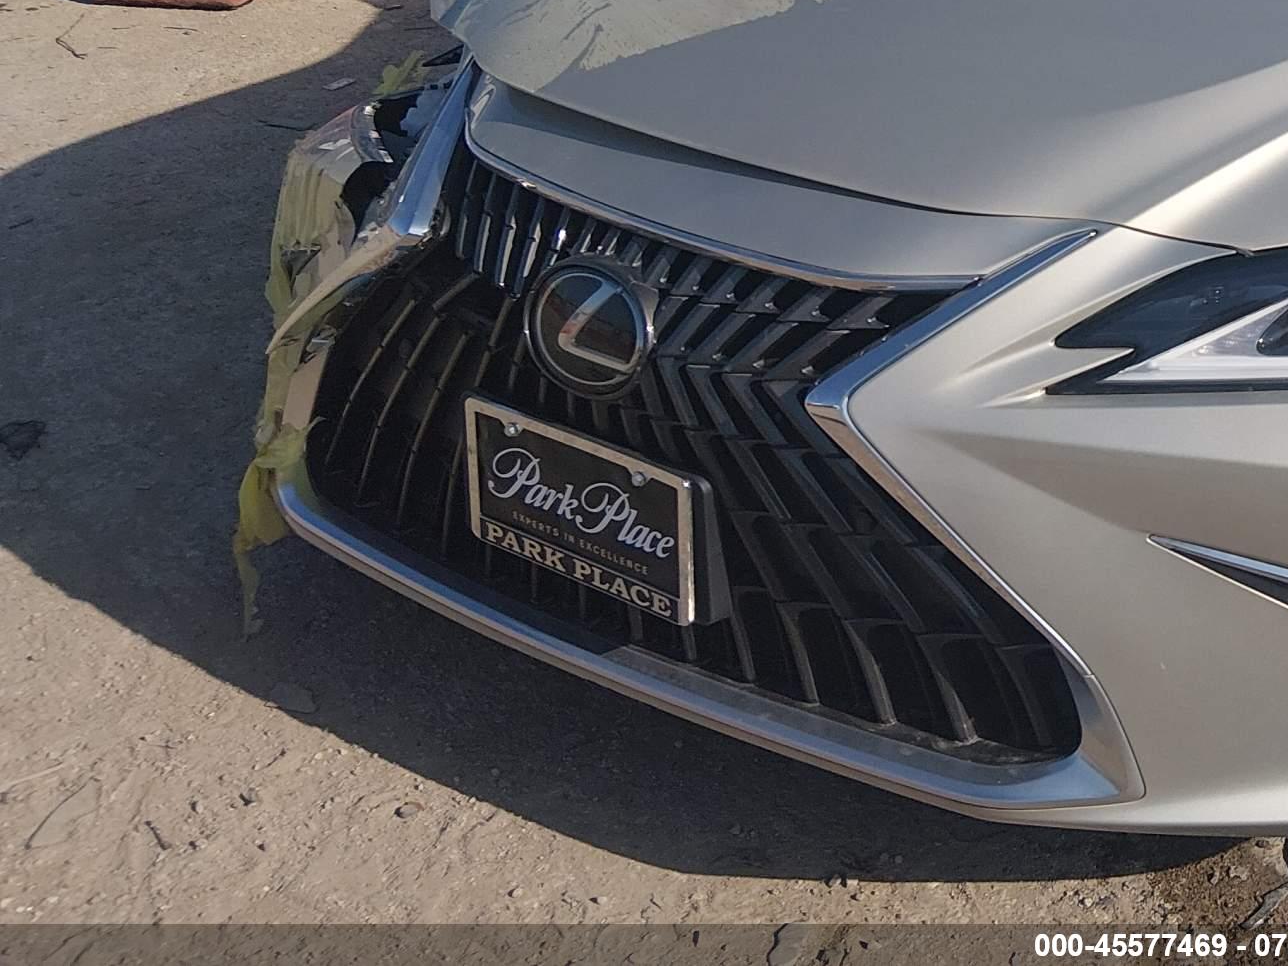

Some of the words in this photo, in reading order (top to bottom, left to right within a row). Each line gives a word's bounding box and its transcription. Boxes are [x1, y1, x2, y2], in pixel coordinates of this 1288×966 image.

[488, 447, 577, 524] Park
[574, 482, 676, 559] Place
[512, 510, 560, 537] EXPERTS
[563, 532, 576, 545] IN
[579, 540, 650, 576] EXCELLENCE
[485, 522, 567, 573] PARK
[572, 558, 672, 618] PLACE
